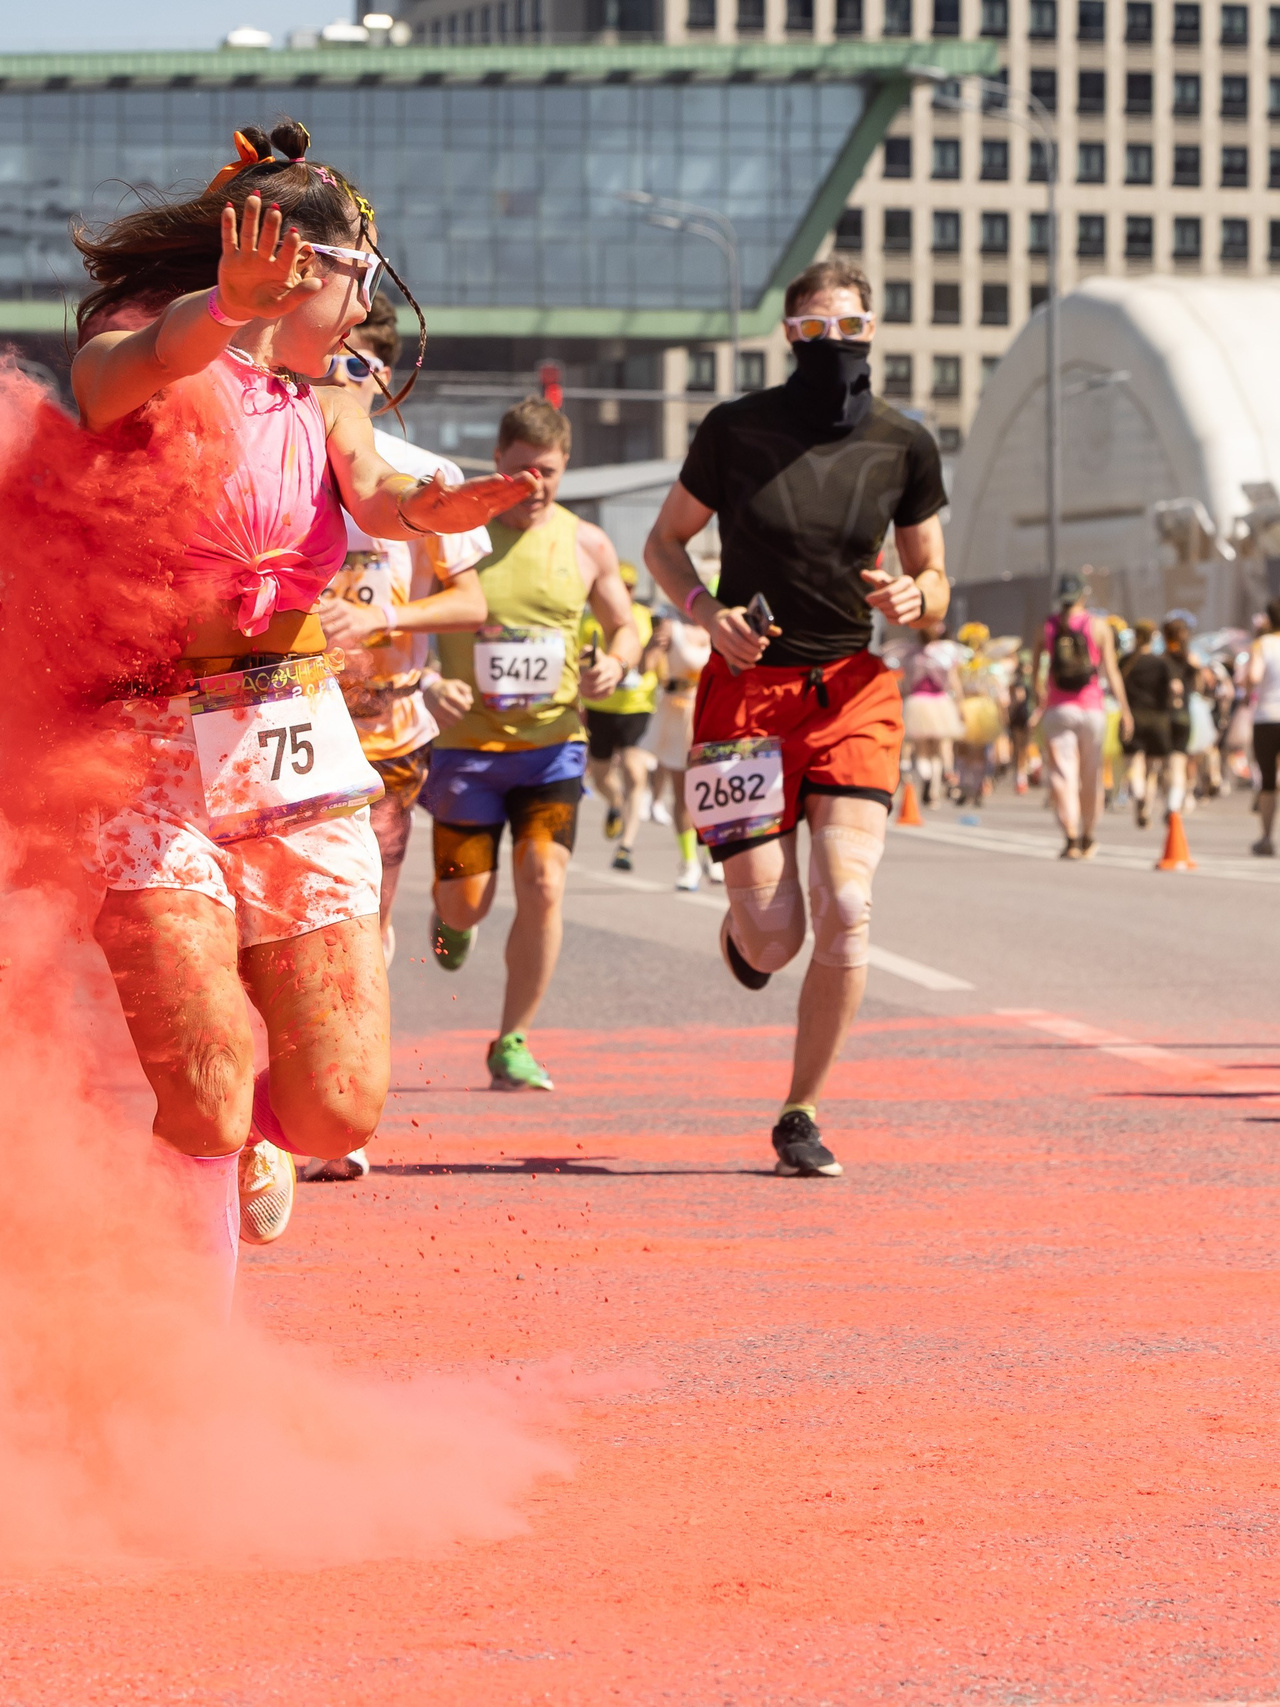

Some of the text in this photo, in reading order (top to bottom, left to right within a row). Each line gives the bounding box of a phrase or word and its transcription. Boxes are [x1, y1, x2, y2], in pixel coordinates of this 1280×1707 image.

[490, 656, 548, 681] 5412
[257, 722, 315, 782] 75
[694, 773, 766, 812] 2682
